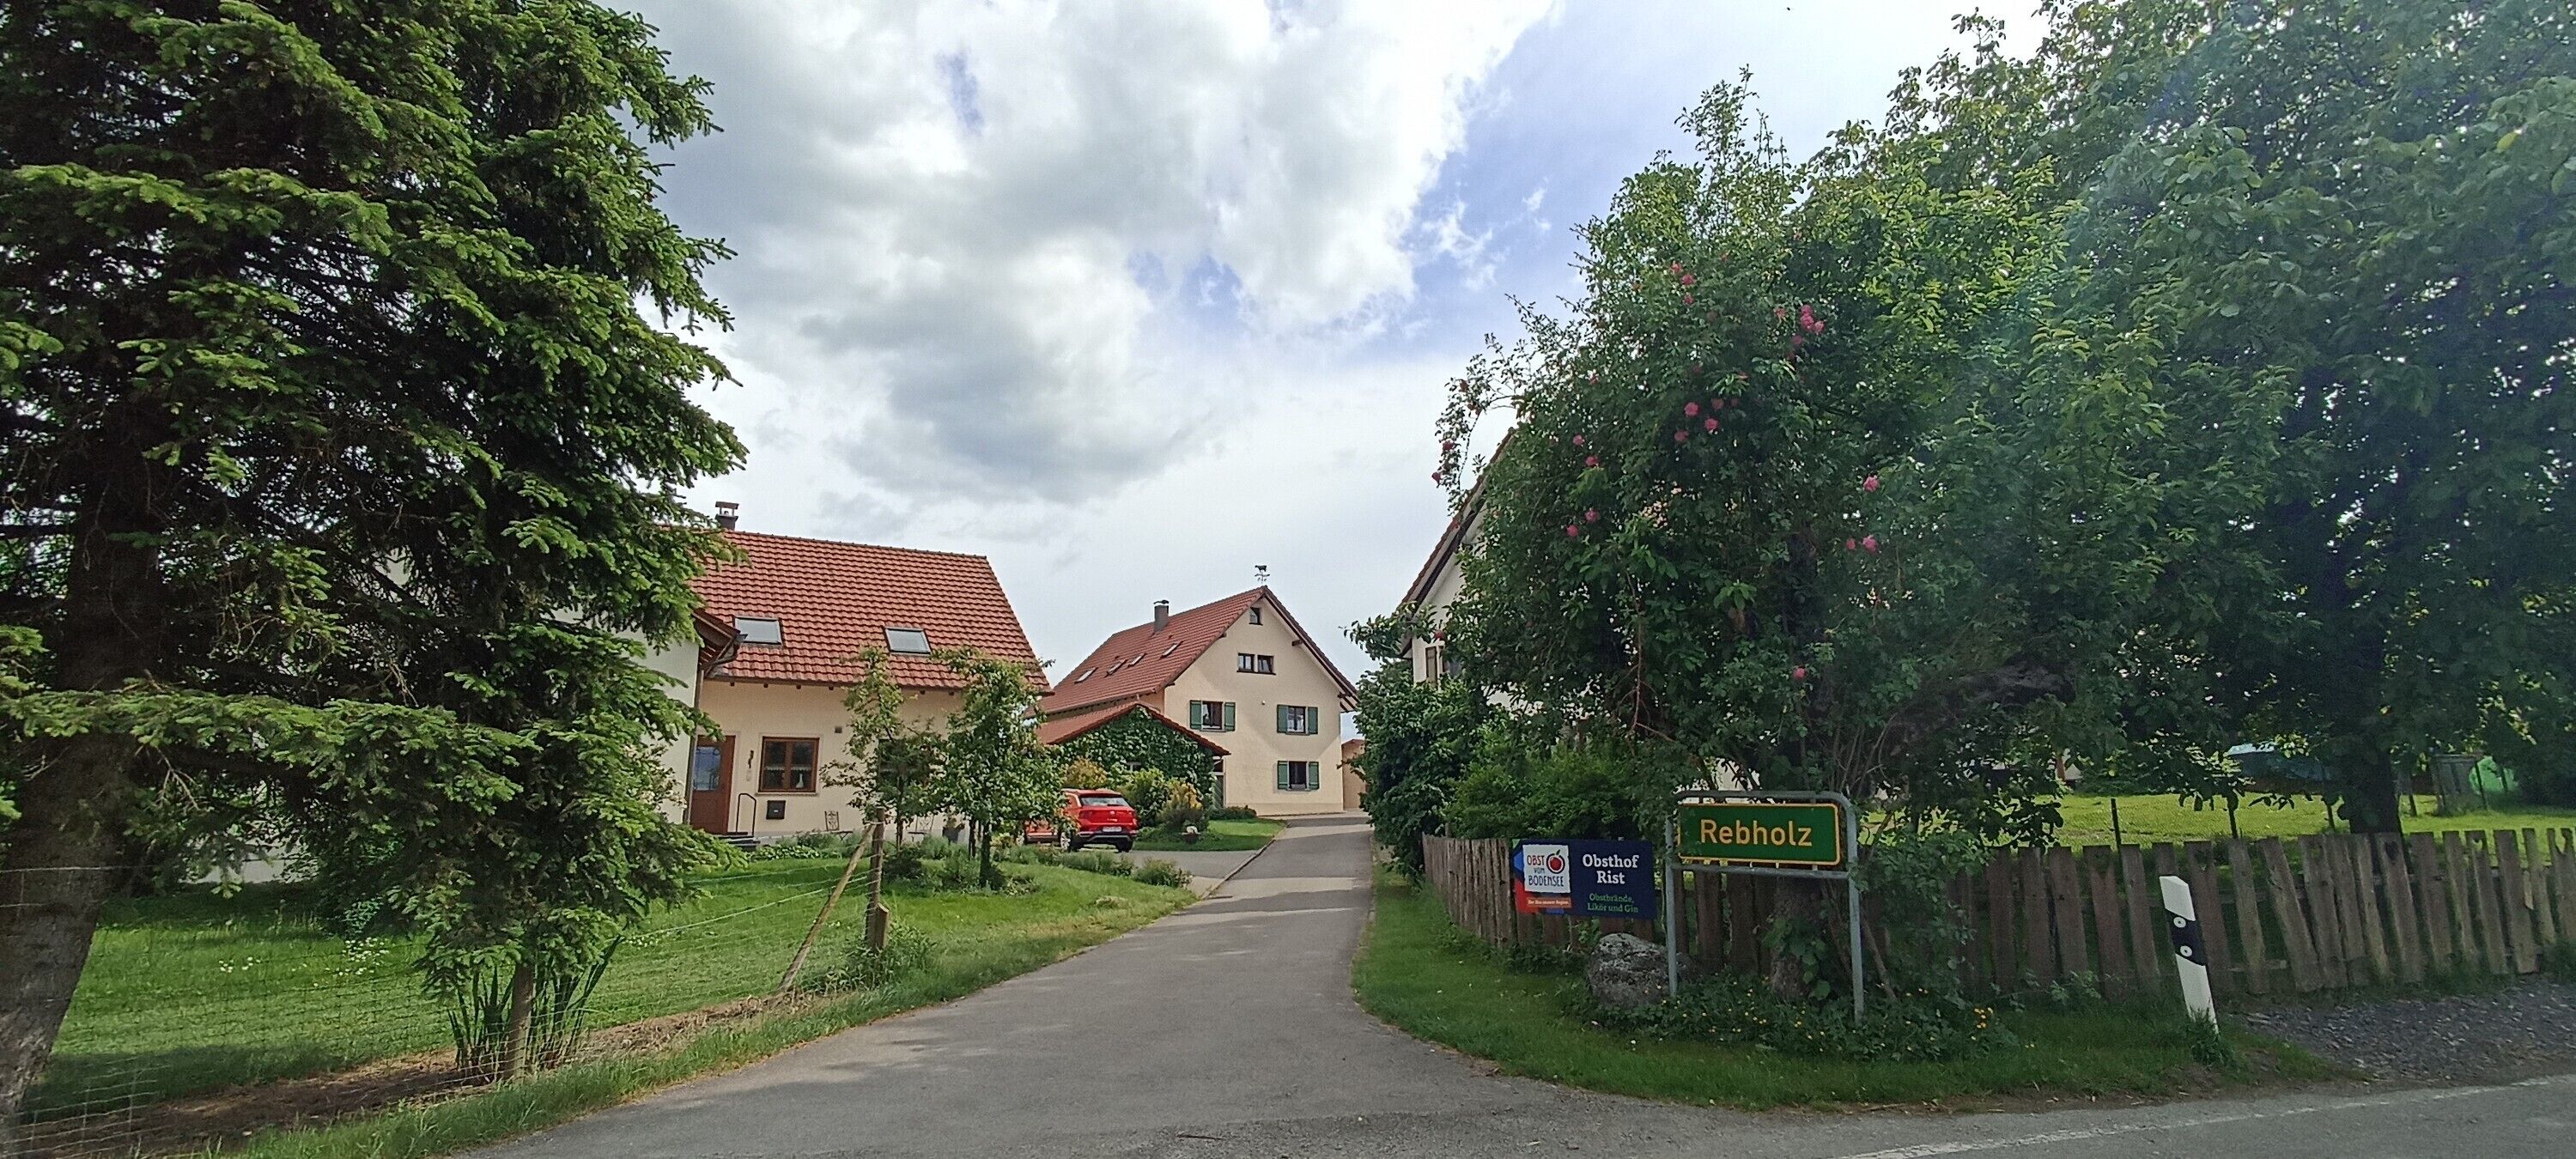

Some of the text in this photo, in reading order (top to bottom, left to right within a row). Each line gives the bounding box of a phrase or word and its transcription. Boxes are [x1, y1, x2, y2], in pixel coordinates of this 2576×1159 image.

[1699, 818, 1813, 846] Rebholz
[1527, 854, 1545, 866] OBST
[1582, 853, 1640, 869] Obsthof
[1528, 875, 1564, 887] BODENSEE
[1596, 870, 1625, 884] Rist
[1608, 904, 1624, 913] und
[1625, 904, 1639, 913] Gin
